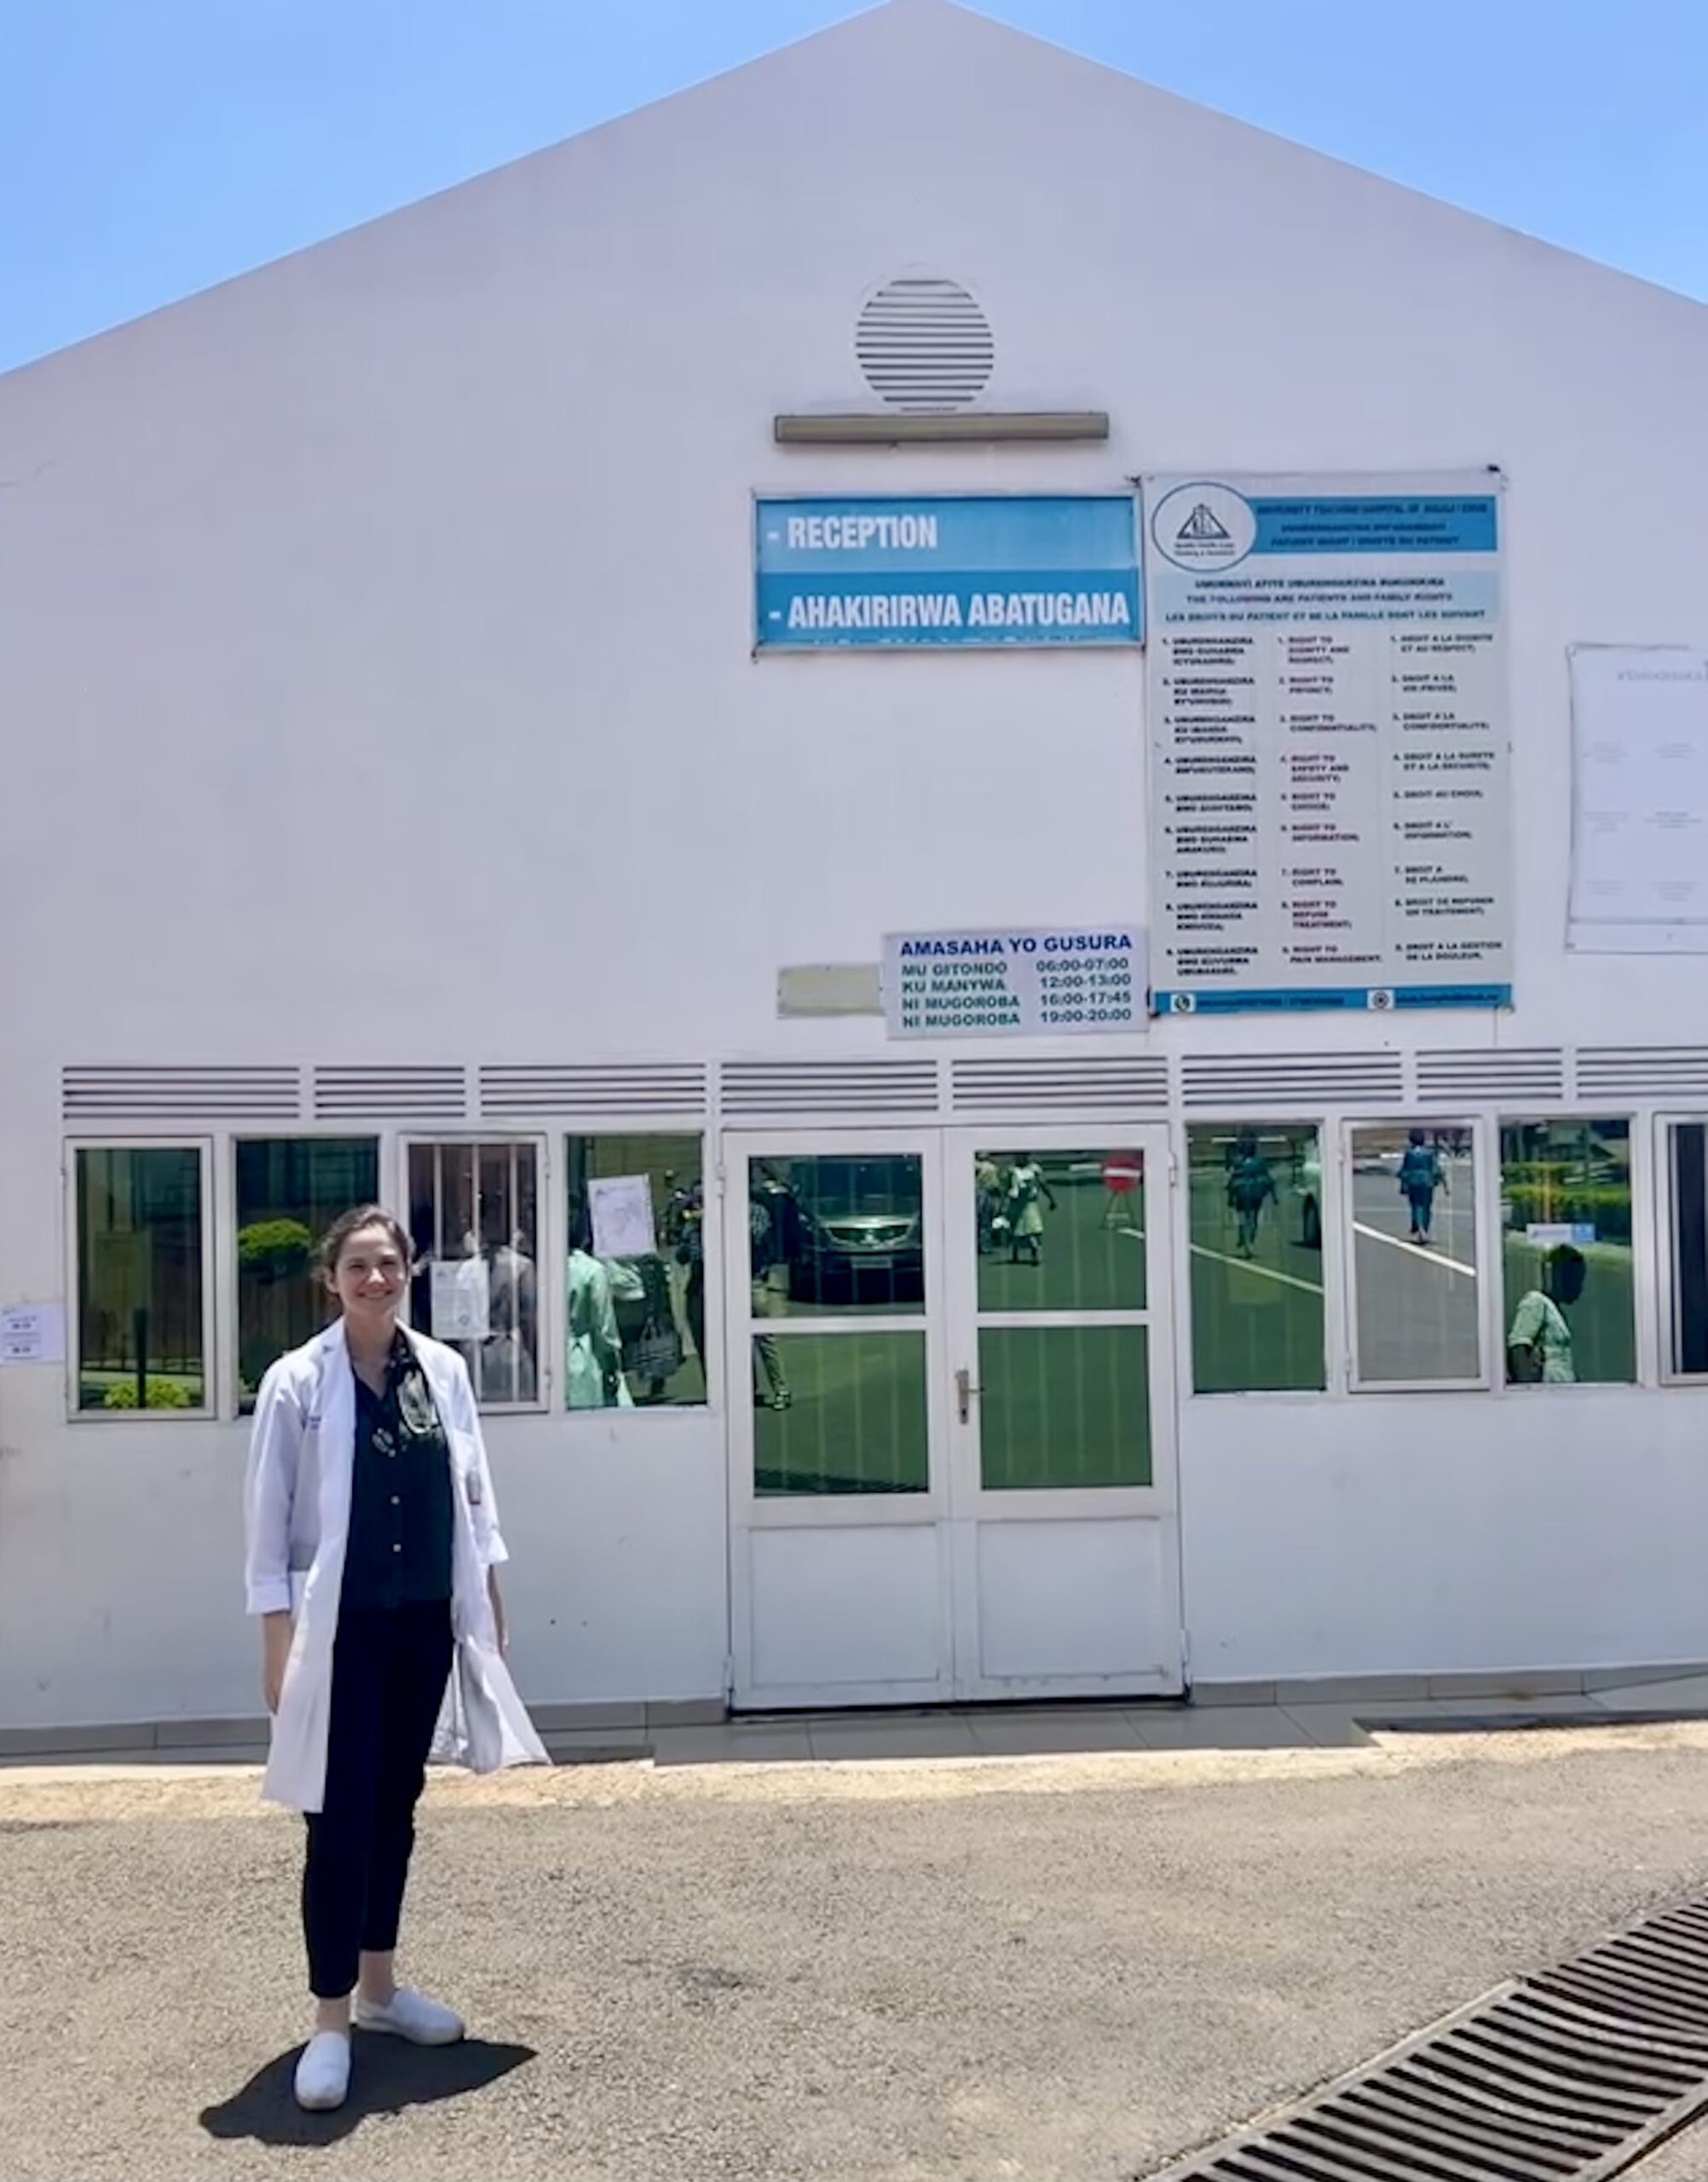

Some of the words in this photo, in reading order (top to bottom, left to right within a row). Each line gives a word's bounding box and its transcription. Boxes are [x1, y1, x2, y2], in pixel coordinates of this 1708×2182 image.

[788, 516, 938, 549] RECEPTION
[788, 595, 962, 628] AHAKIRIRWA
[968, 592, 1130, 626] ABATUGANA
[901, 939, 1004, 956] AMASAHA
[1009, 938, 1036, 953] YO
[1044, 934, 1132, 952] GUSURA
[902, 964, 926, 977] MU
[932, 961, 1007, 975] GITONDO
[902, 981, 926, 993] KU
[932, 978, 1006, 992] MANYWA
[902, 998, 920, 1010] NI
[926, 996, 1021, 1010] MUGOROBA
[903, 1014, 920, 1028] NI
[926, 1013, 1021, 1028] MUGOROBA
[1040, 1007, 1132, 1024] 19:00-20:00
